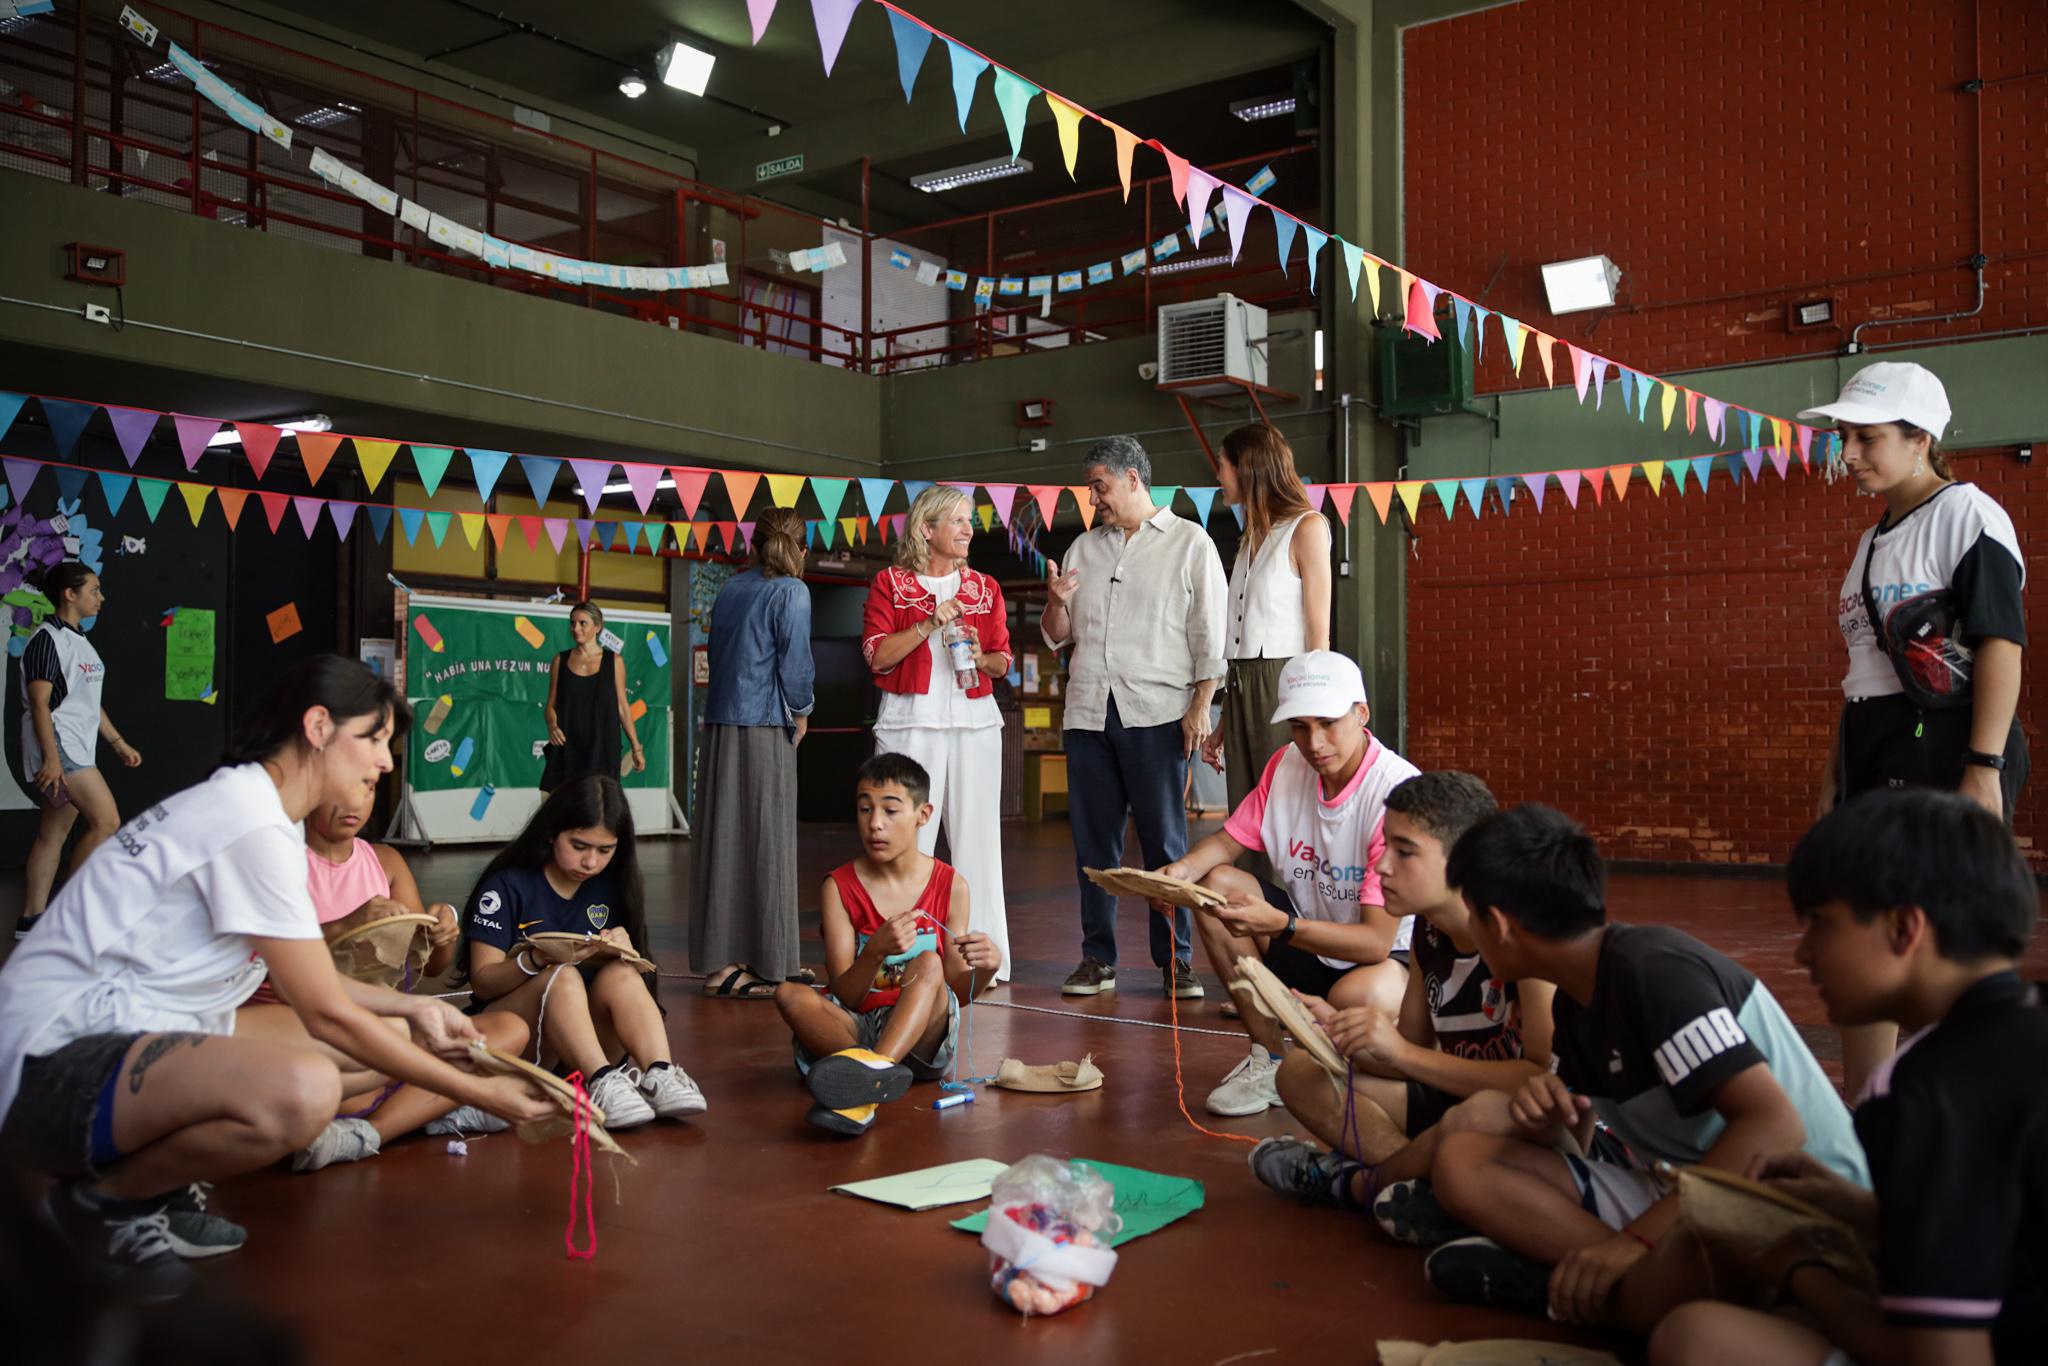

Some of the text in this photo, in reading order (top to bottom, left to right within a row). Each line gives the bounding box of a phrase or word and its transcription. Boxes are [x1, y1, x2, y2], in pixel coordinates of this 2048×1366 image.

[770, 159, 801, 174] SALIDA
[471, 660, 491, 672] UNA
[495, 659, 516, 673] VEZ
[518, 661, 531, 672] UN
[537, 662, 551, 673] NU
[1293, 866, 1314, 881] en
[473, 914, 503, 930] TOTAL
[1652, 1006, 1746, 1087] UMA
